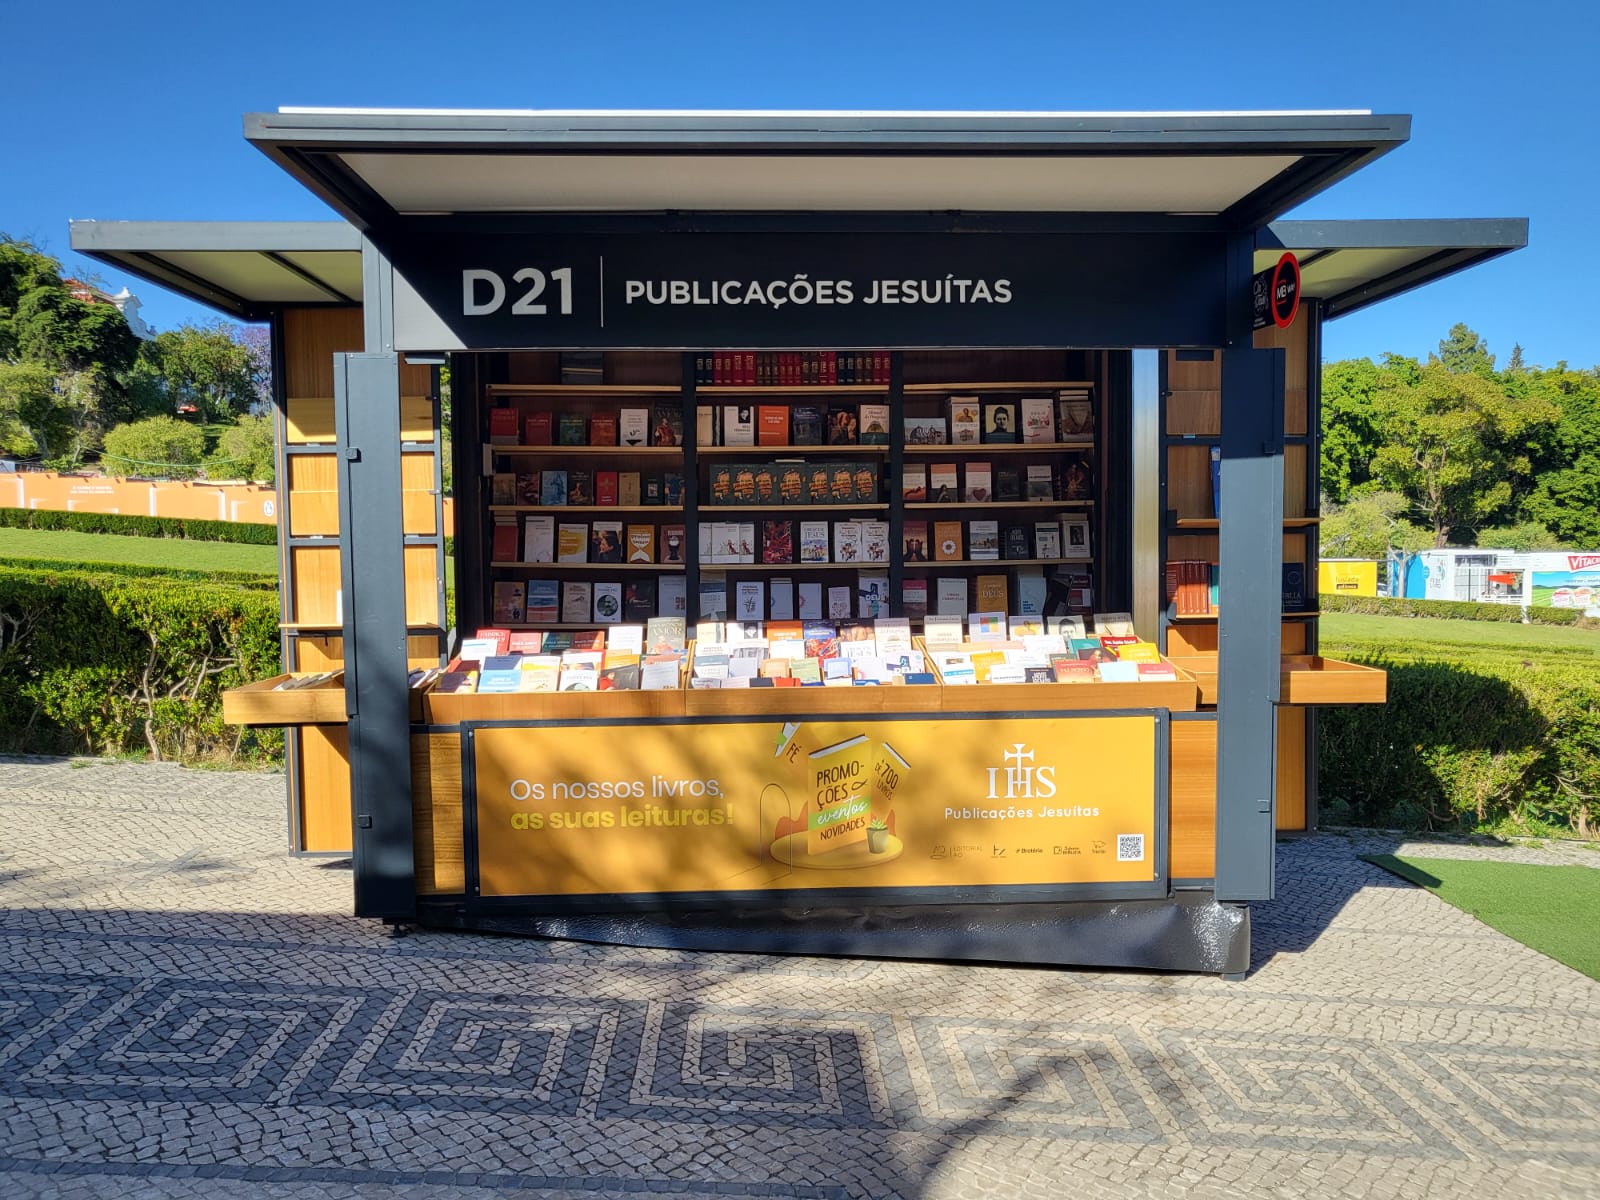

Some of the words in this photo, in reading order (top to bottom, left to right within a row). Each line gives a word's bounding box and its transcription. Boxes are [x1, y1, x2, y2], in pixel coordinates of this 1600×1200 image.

[463, 268, 574, 315] D21
[625, 274, 854, 310] PUBLICAÇÕES
[863, 273, 1013, 305] JESUÍTAS
[1570, 557, 1600, 569] VITAC
[816, 760, 865, 788] PROMO-
[881, 763, 898, 789] 700
[985, 764, 1057, 799] IHS
[510, 779, 545, 801] Os
[552, 779, 645, 801] nossos
[651, 775, 725, 800] livros,
[816, 783, 849, 811] ÇÕES
[510, 811, 544, 830] as
[549, 808, 616, 829] suas
[620, 803, 735, 828] leituras!
[817, 794, 868, 825] eventos
[945, 806, 1033, 821] Publicações
[1038, 805, 1100, 818] Jesuítas
[820, 816, 866, 841] NOVIDADES
